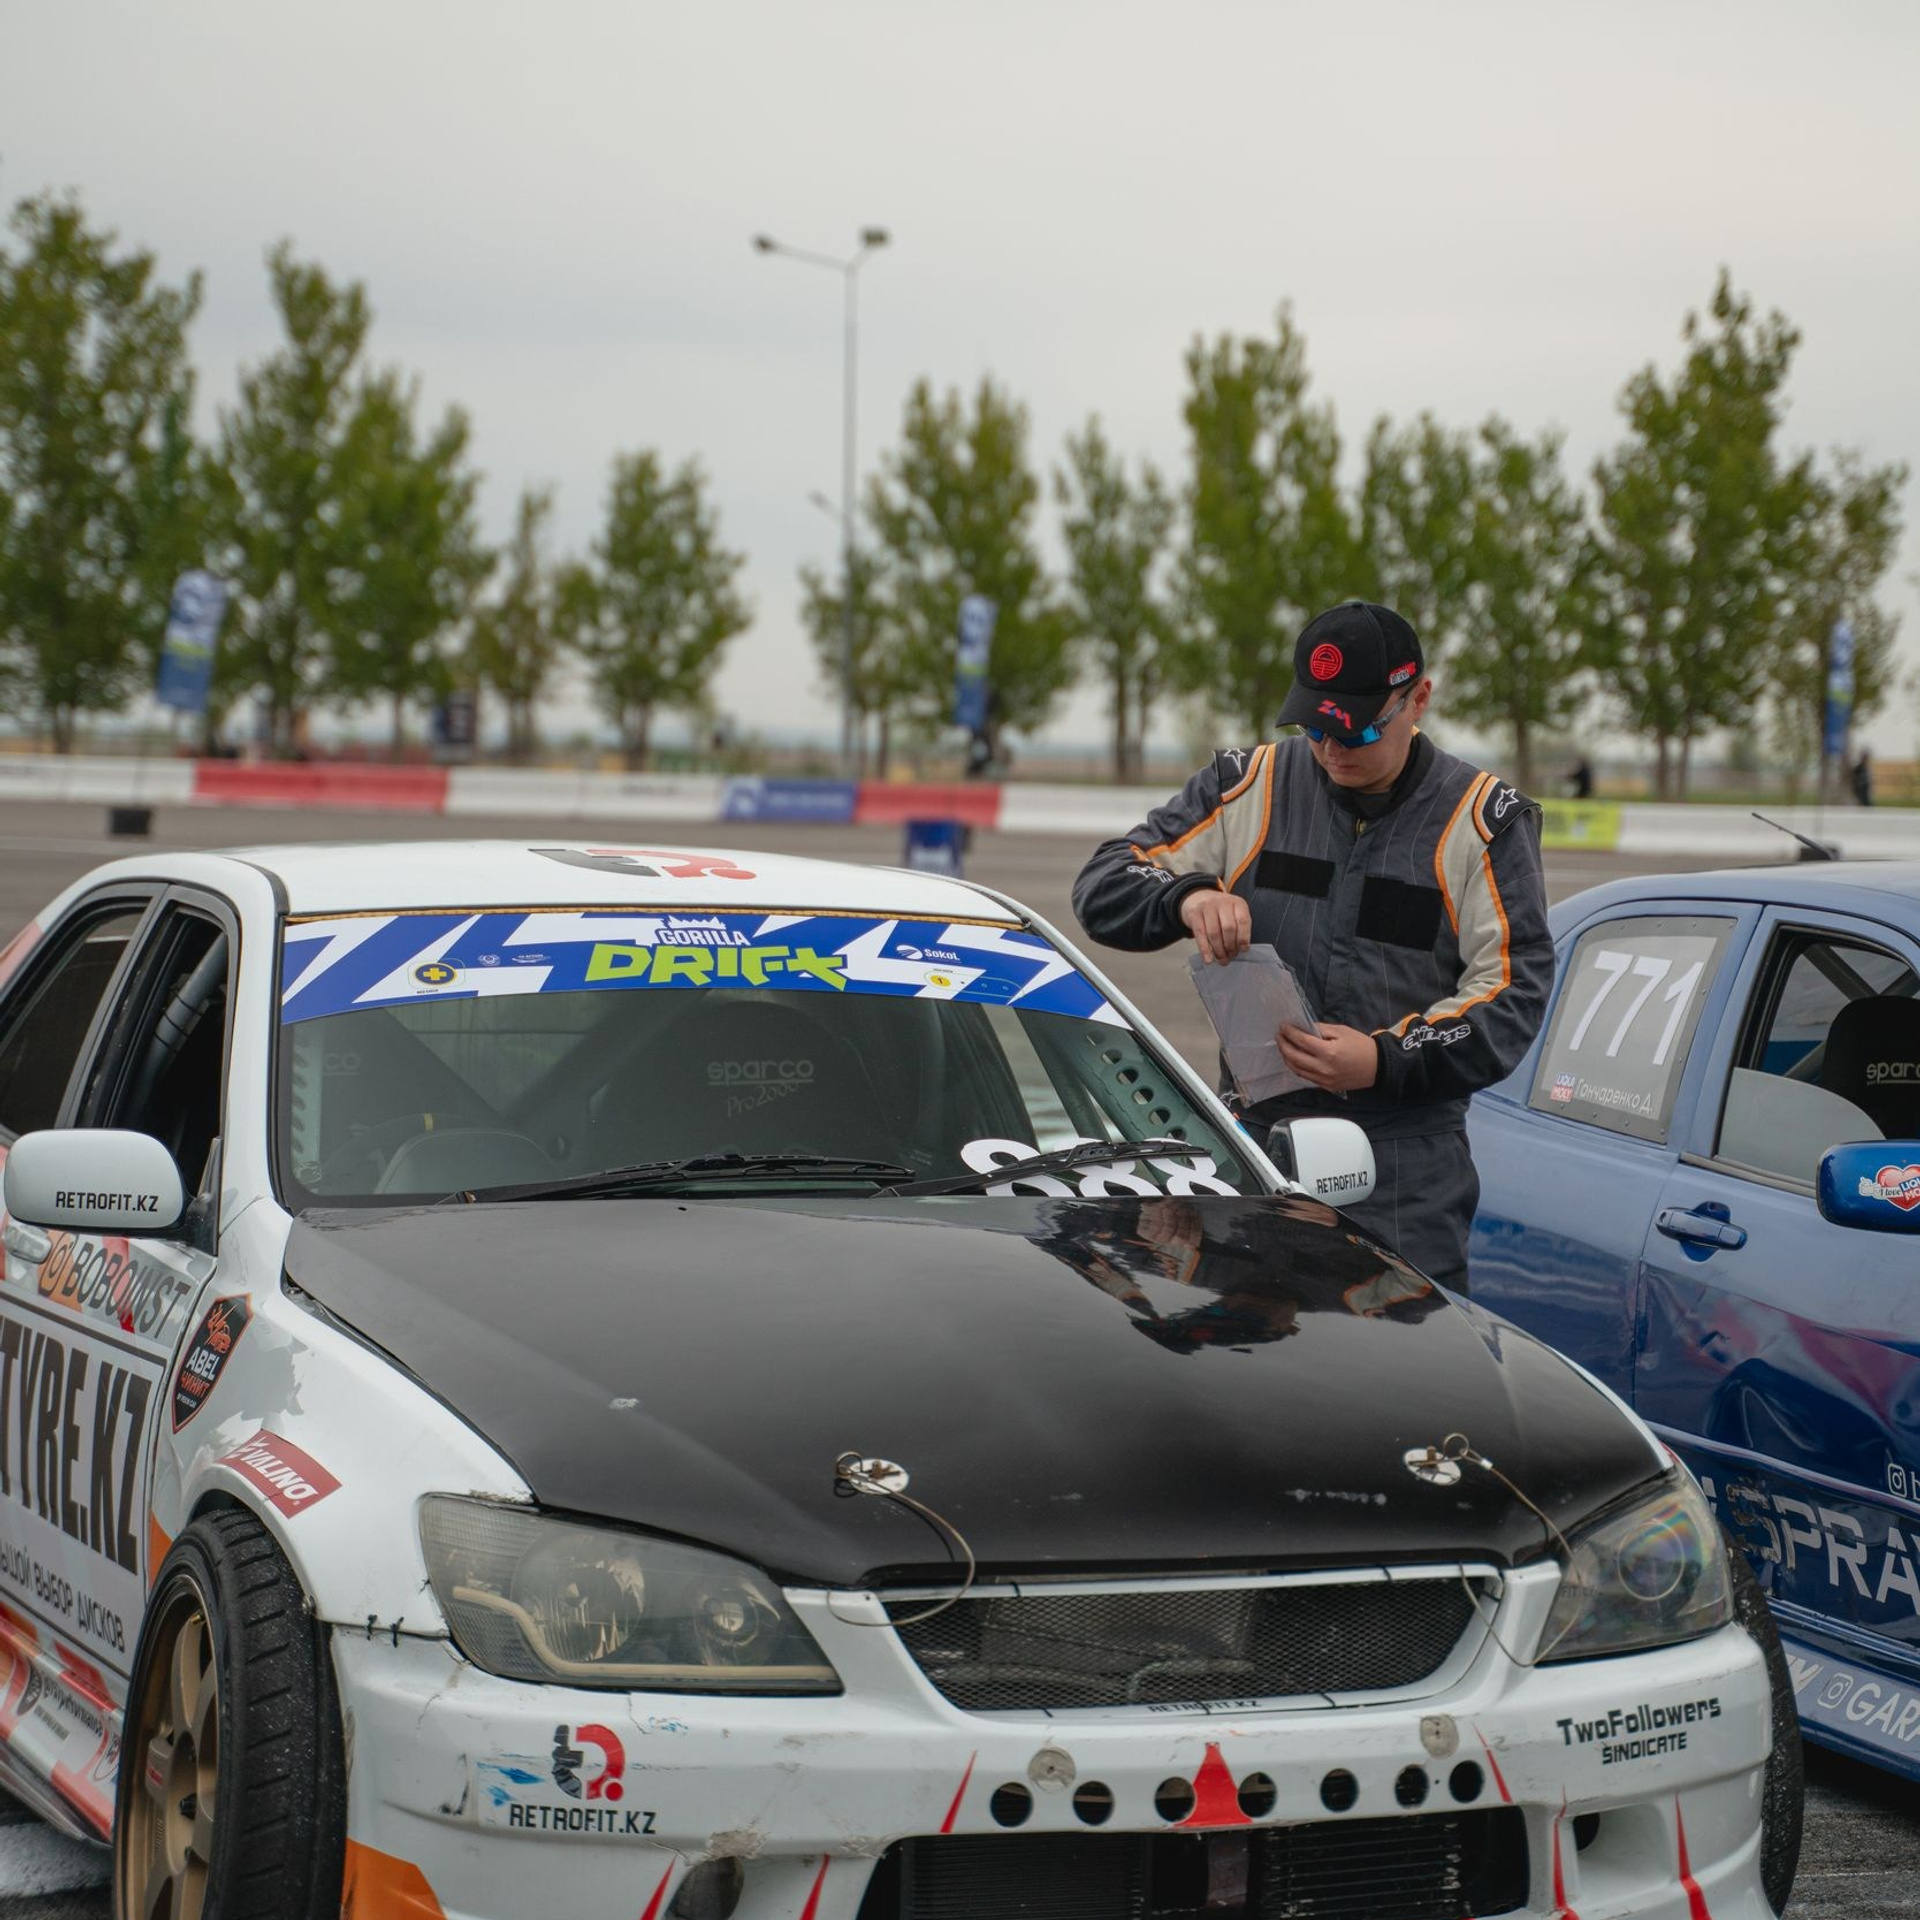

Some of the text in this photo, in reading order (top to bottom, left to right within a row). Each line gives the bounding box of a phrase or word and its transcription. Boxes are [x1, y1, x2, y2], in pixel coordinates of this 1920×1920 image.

[659, 930, 751, 946] GORILLA
[585, 943, 847, 992] DRIFT
[1569, 950, 1704, 1066] 771
[707, 1060, 814, 1087] sparco
[1576, 1078, 1640, 1109] Гончаренко
[1316, 1171, 1368, 1194] RETROFIT.KZ
[56, 1191, 158, 1212] RETROFIT.KZ
[61, 1241, 192, 1340] BOBOINST
[186, 1346, 220, 1381] ABEL
[0, 1314, 153, 1576] TYRE.KZ
[240, 1448, 318, 1501] VALINO
[34, 1561, 73, 1617] ВЫБОР
[77, 1590, 125, 1653] ДИСКОВ
[1556, 1697, 1721, 1746] TwoFollowers
[1602, 1732, 1687, 1765] SINDICATE
[510, 1804, 656, 1835] RETROFIT.KZ
